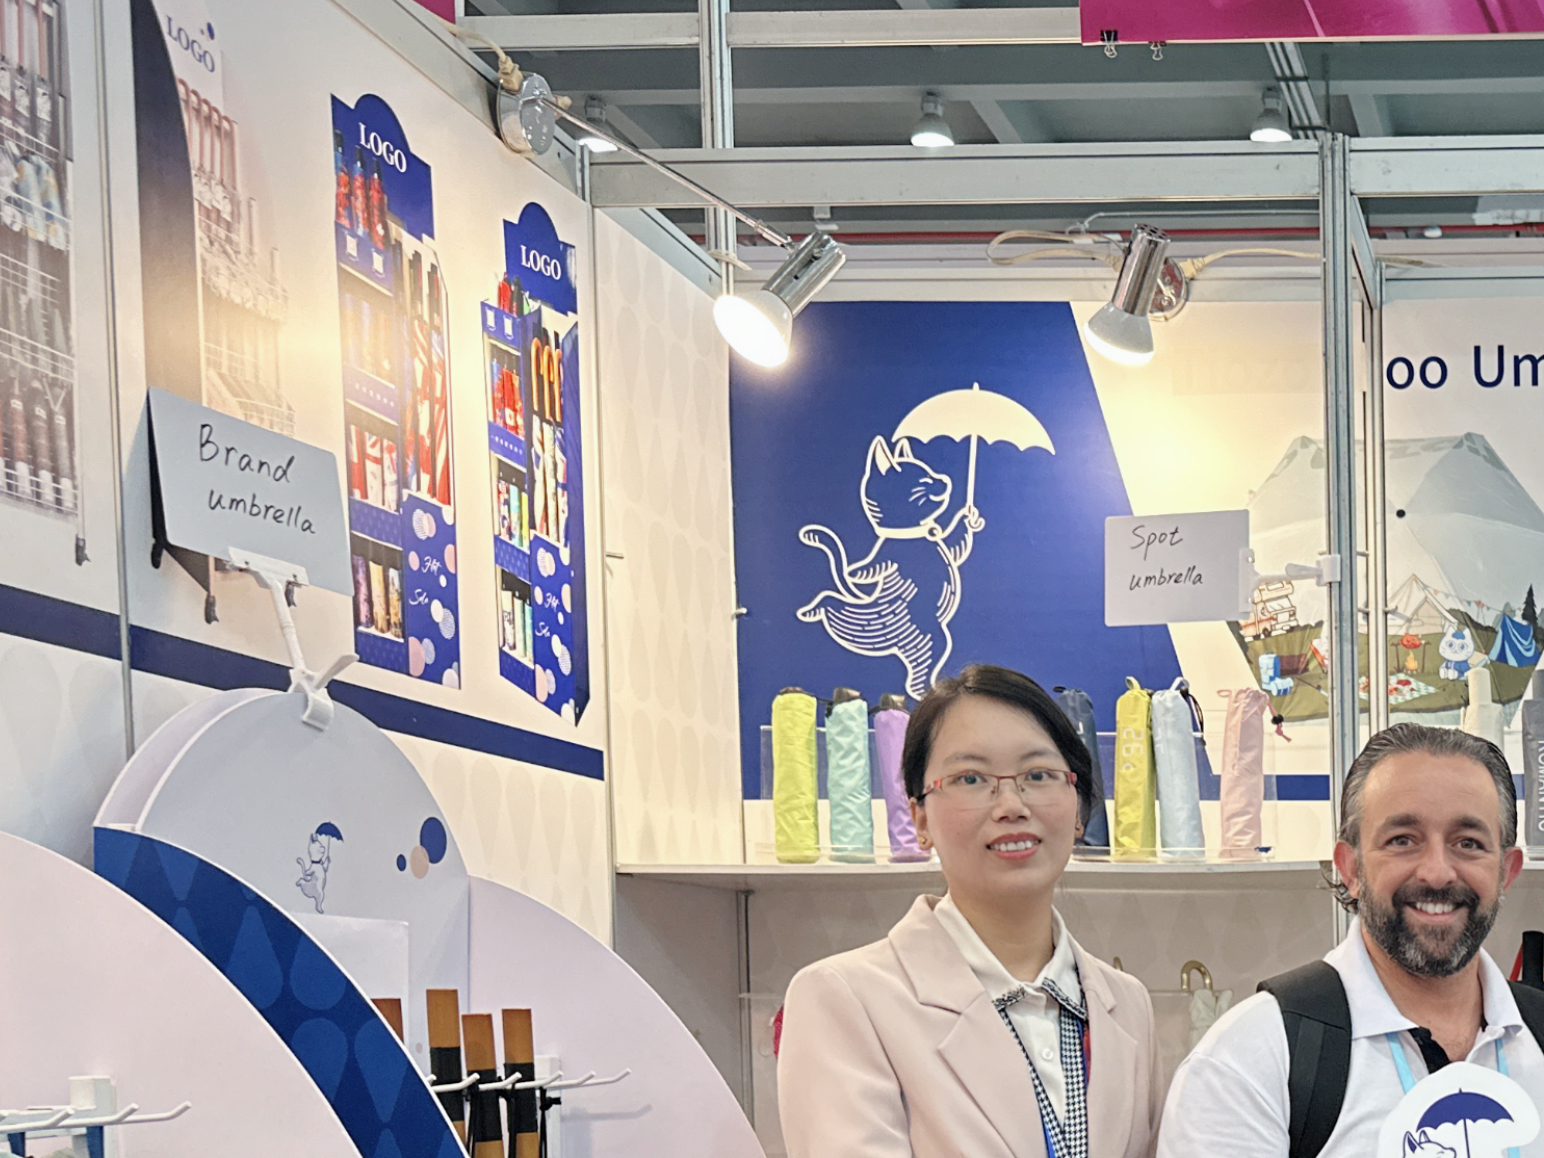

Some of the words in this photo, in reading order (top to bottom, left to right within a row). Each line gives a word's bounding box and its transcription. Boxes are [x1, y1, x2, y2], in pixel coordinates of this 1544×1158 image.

[166, 15, 215, 73] LOGO
[359, 122, 407, 173] LOGO
[520, 245, 561, 281] LOGO
[200, 424, 295, 483] Brand
[209, 490, 316, 534] umbrella
[1130, 525, 1183, 561] Spot
[1129, 565, 1203, 591] umbrella
